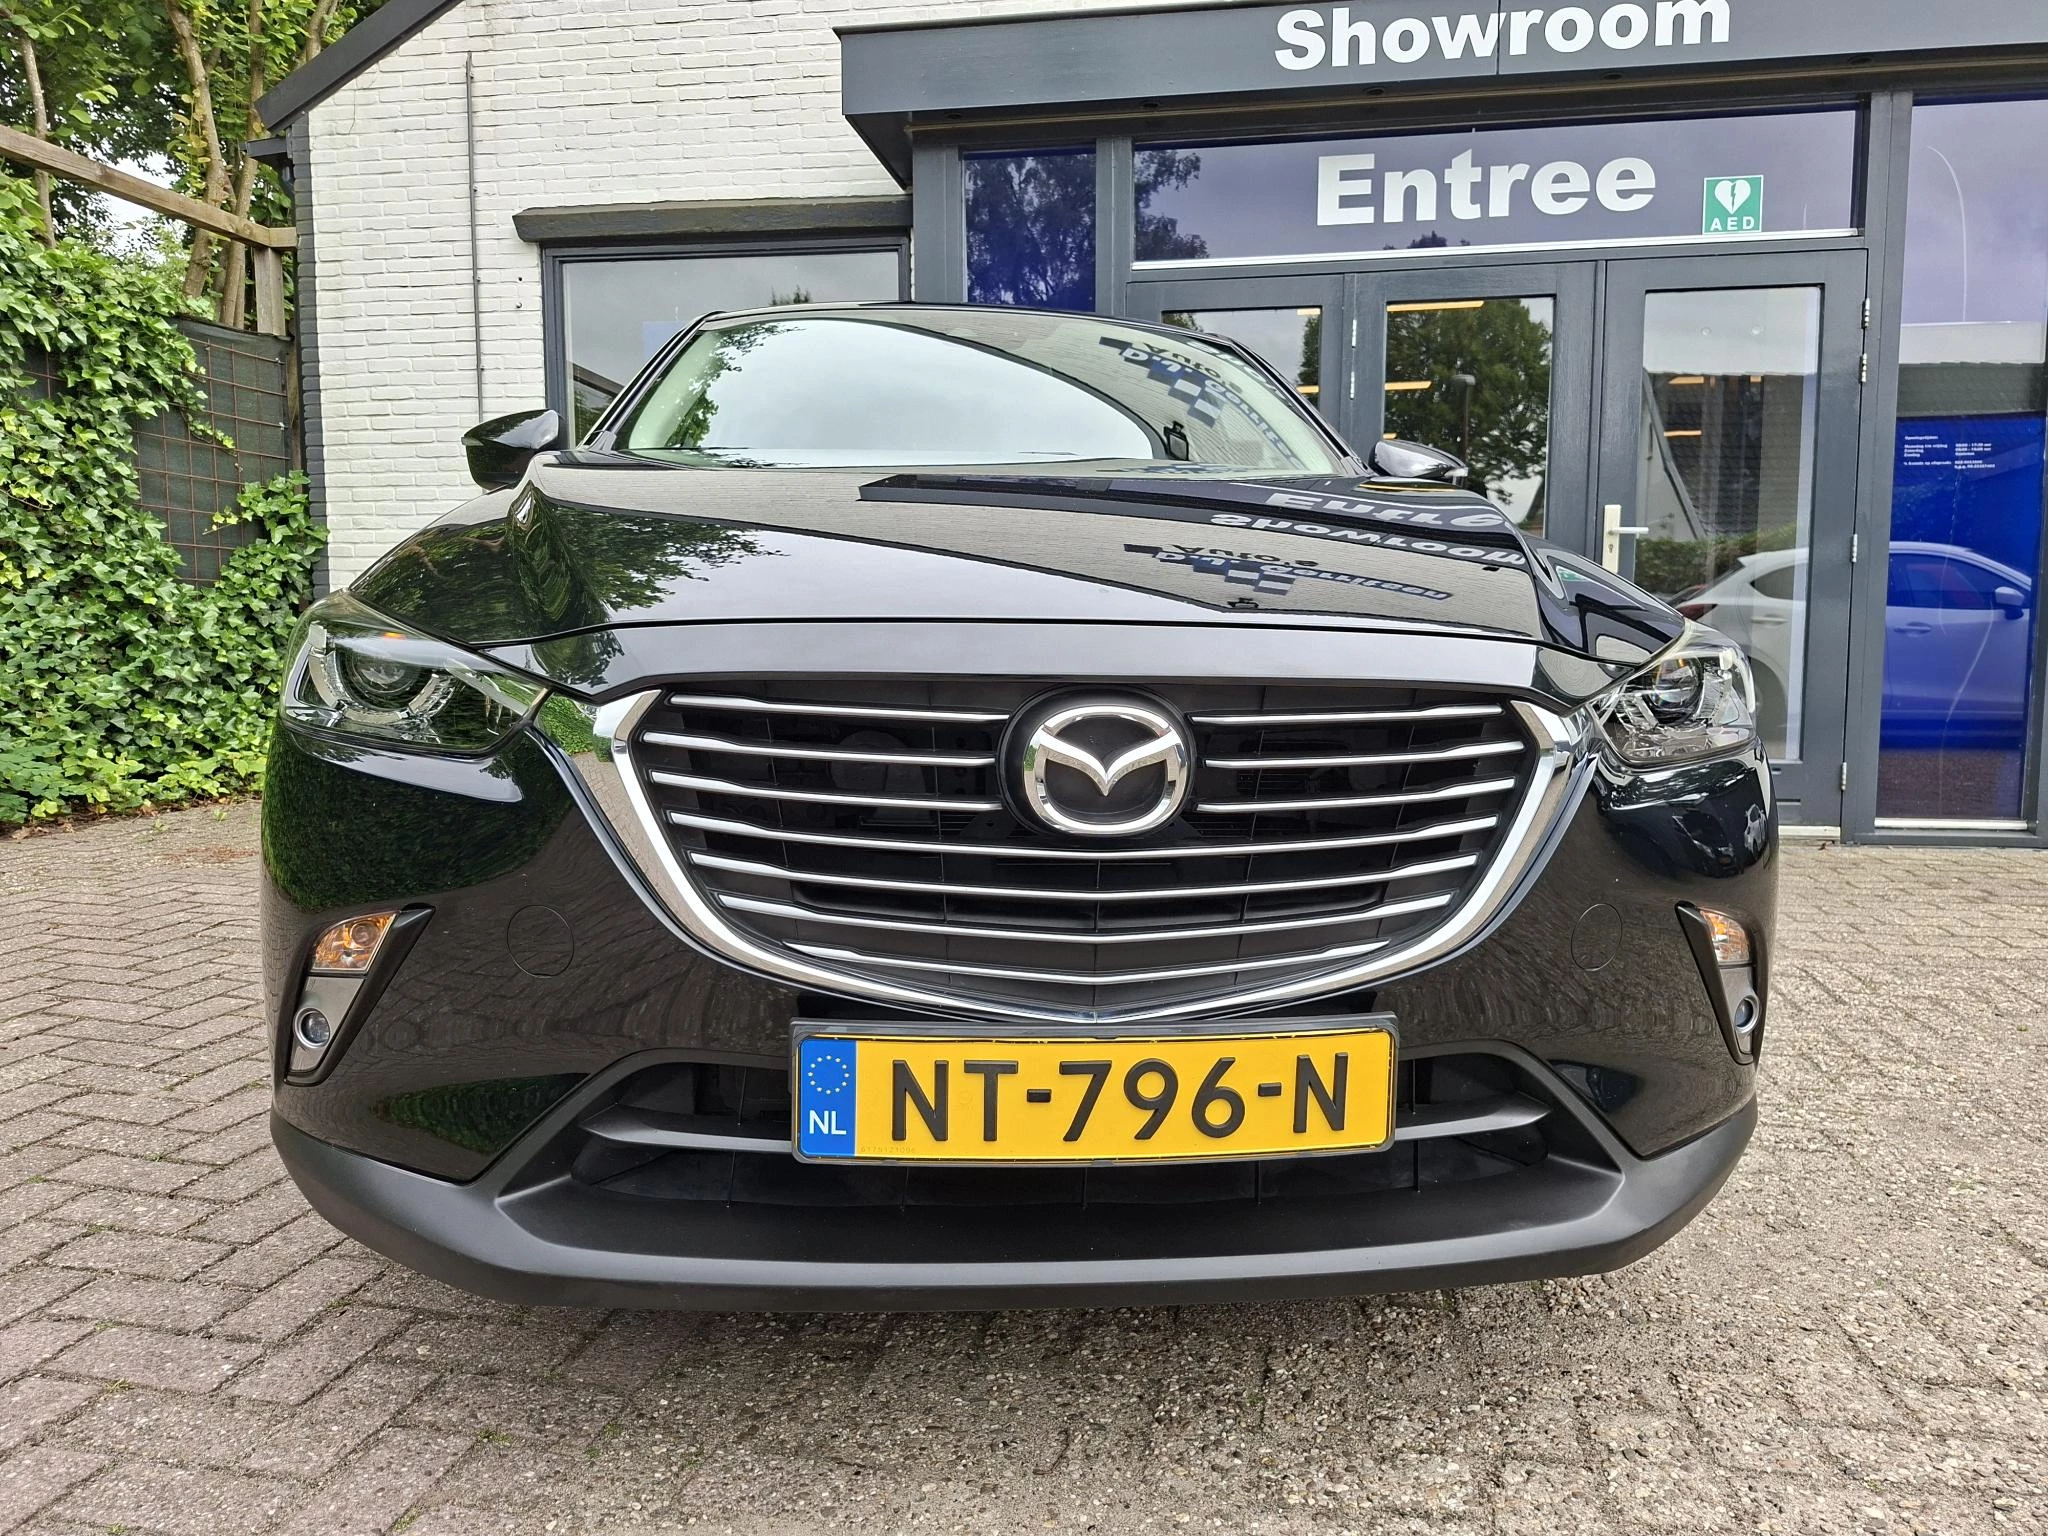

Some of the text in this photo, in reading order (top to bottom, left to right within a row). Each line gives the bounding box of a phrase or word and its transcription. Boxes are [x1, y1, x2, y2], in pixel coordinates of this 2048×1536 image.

[1275, 0, 1730, 71] Showroom
[1316, 149, 1657, 226] Entree
[1711, 216, 1754, 232] AED
[808, 1110, 847, 1135] NL
[891, 1052, 1349, 1141] NT-796-N
